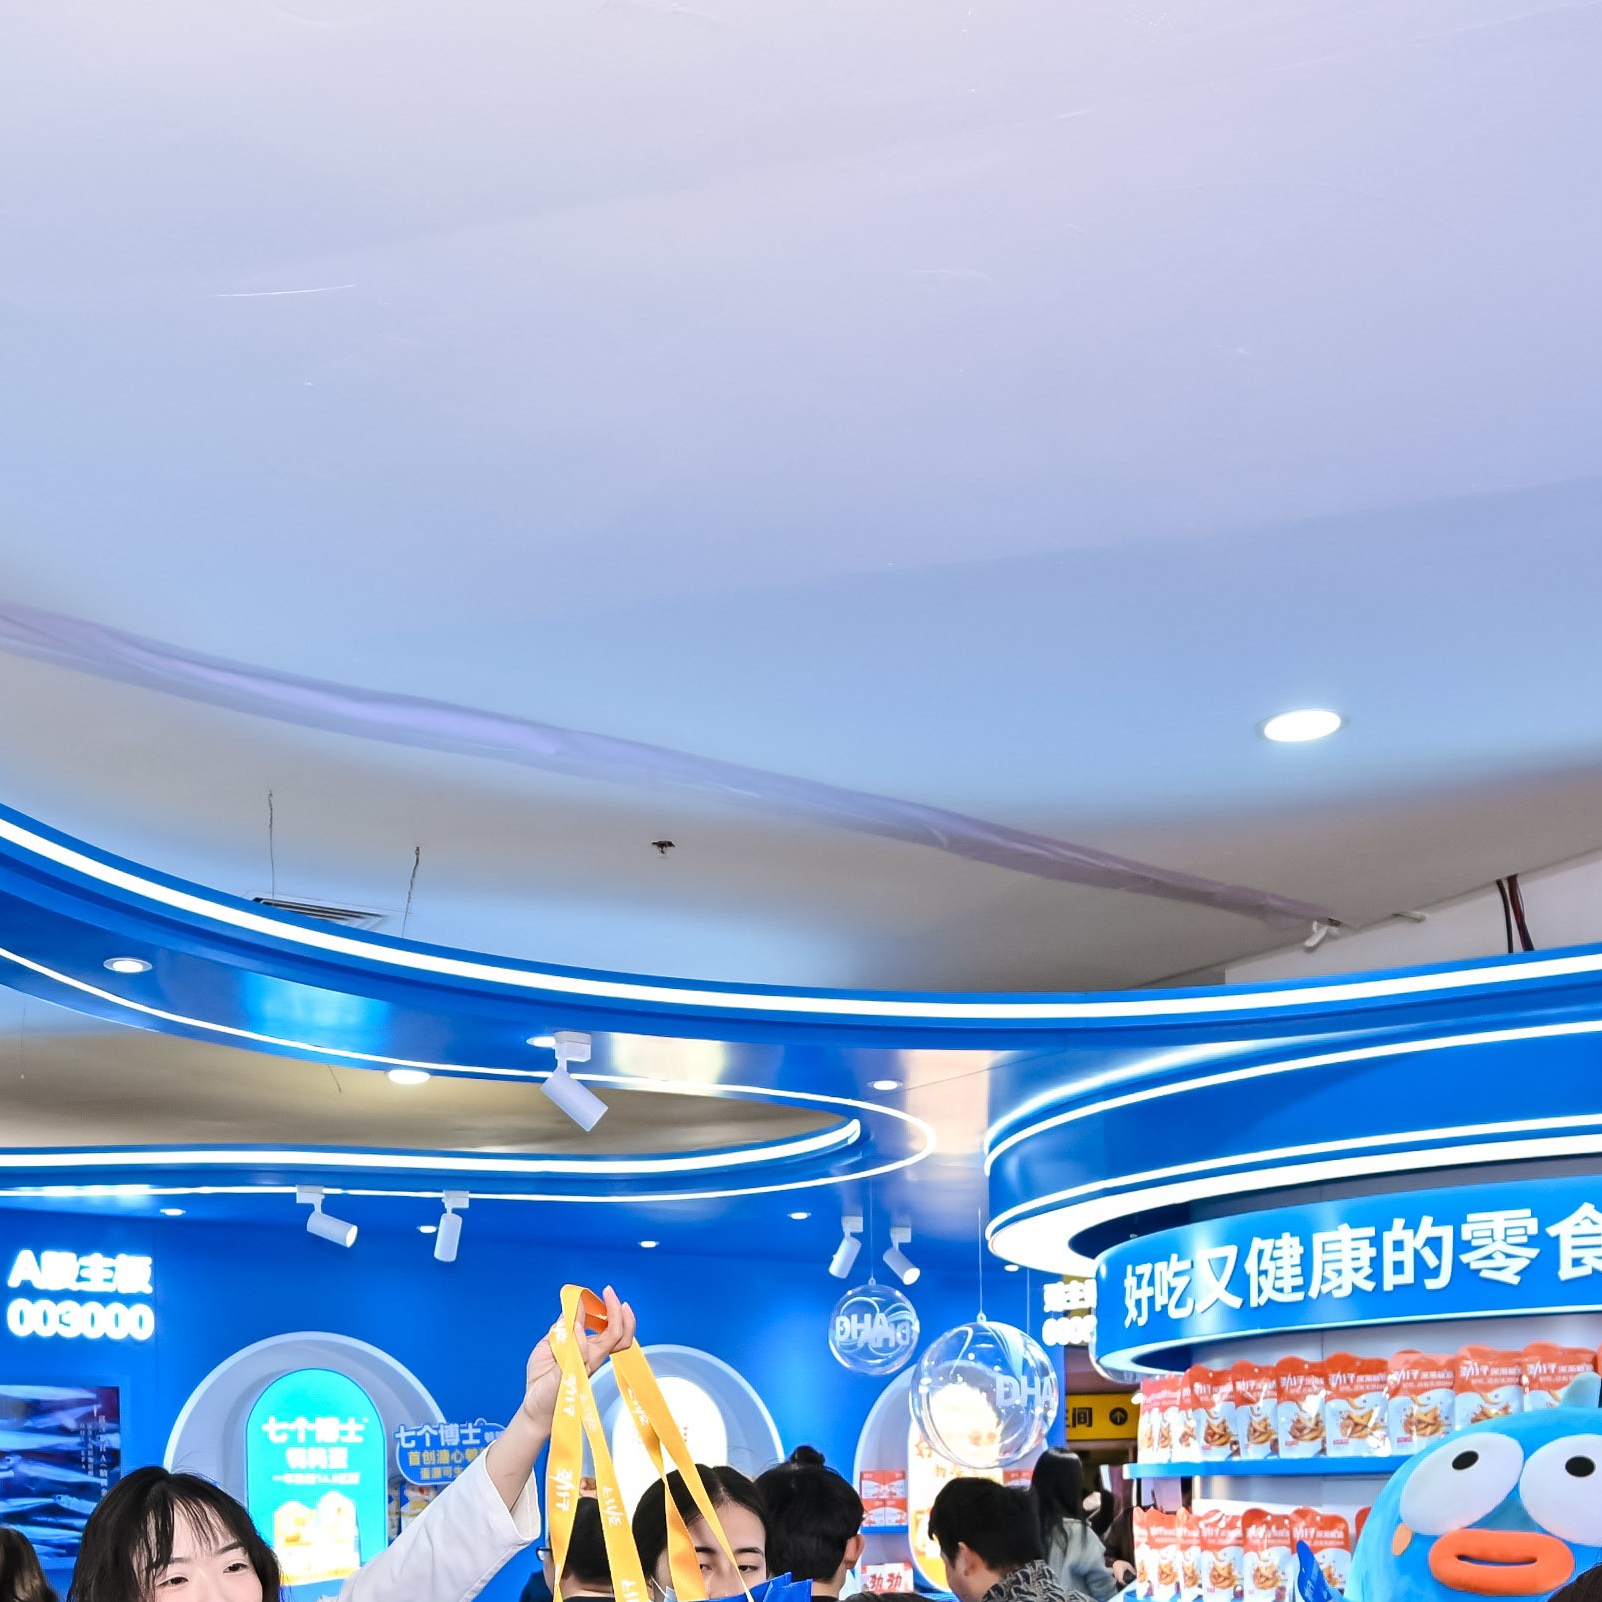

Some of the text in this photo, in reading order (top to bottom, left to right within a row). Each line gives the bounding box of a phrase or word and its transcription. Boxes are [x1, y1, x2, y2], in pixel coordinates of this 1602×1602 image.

[7, 1249, 154, 1294] A股主板
[7, 1299, 155, 1341] 003000
[836, 1312, 889, 1341] DHA
[995, 1374, 1055, 1408] DHA
[262, 1416, 365, 1443] 七个博士
[396, 1424, 481, 1448] 七个博士
